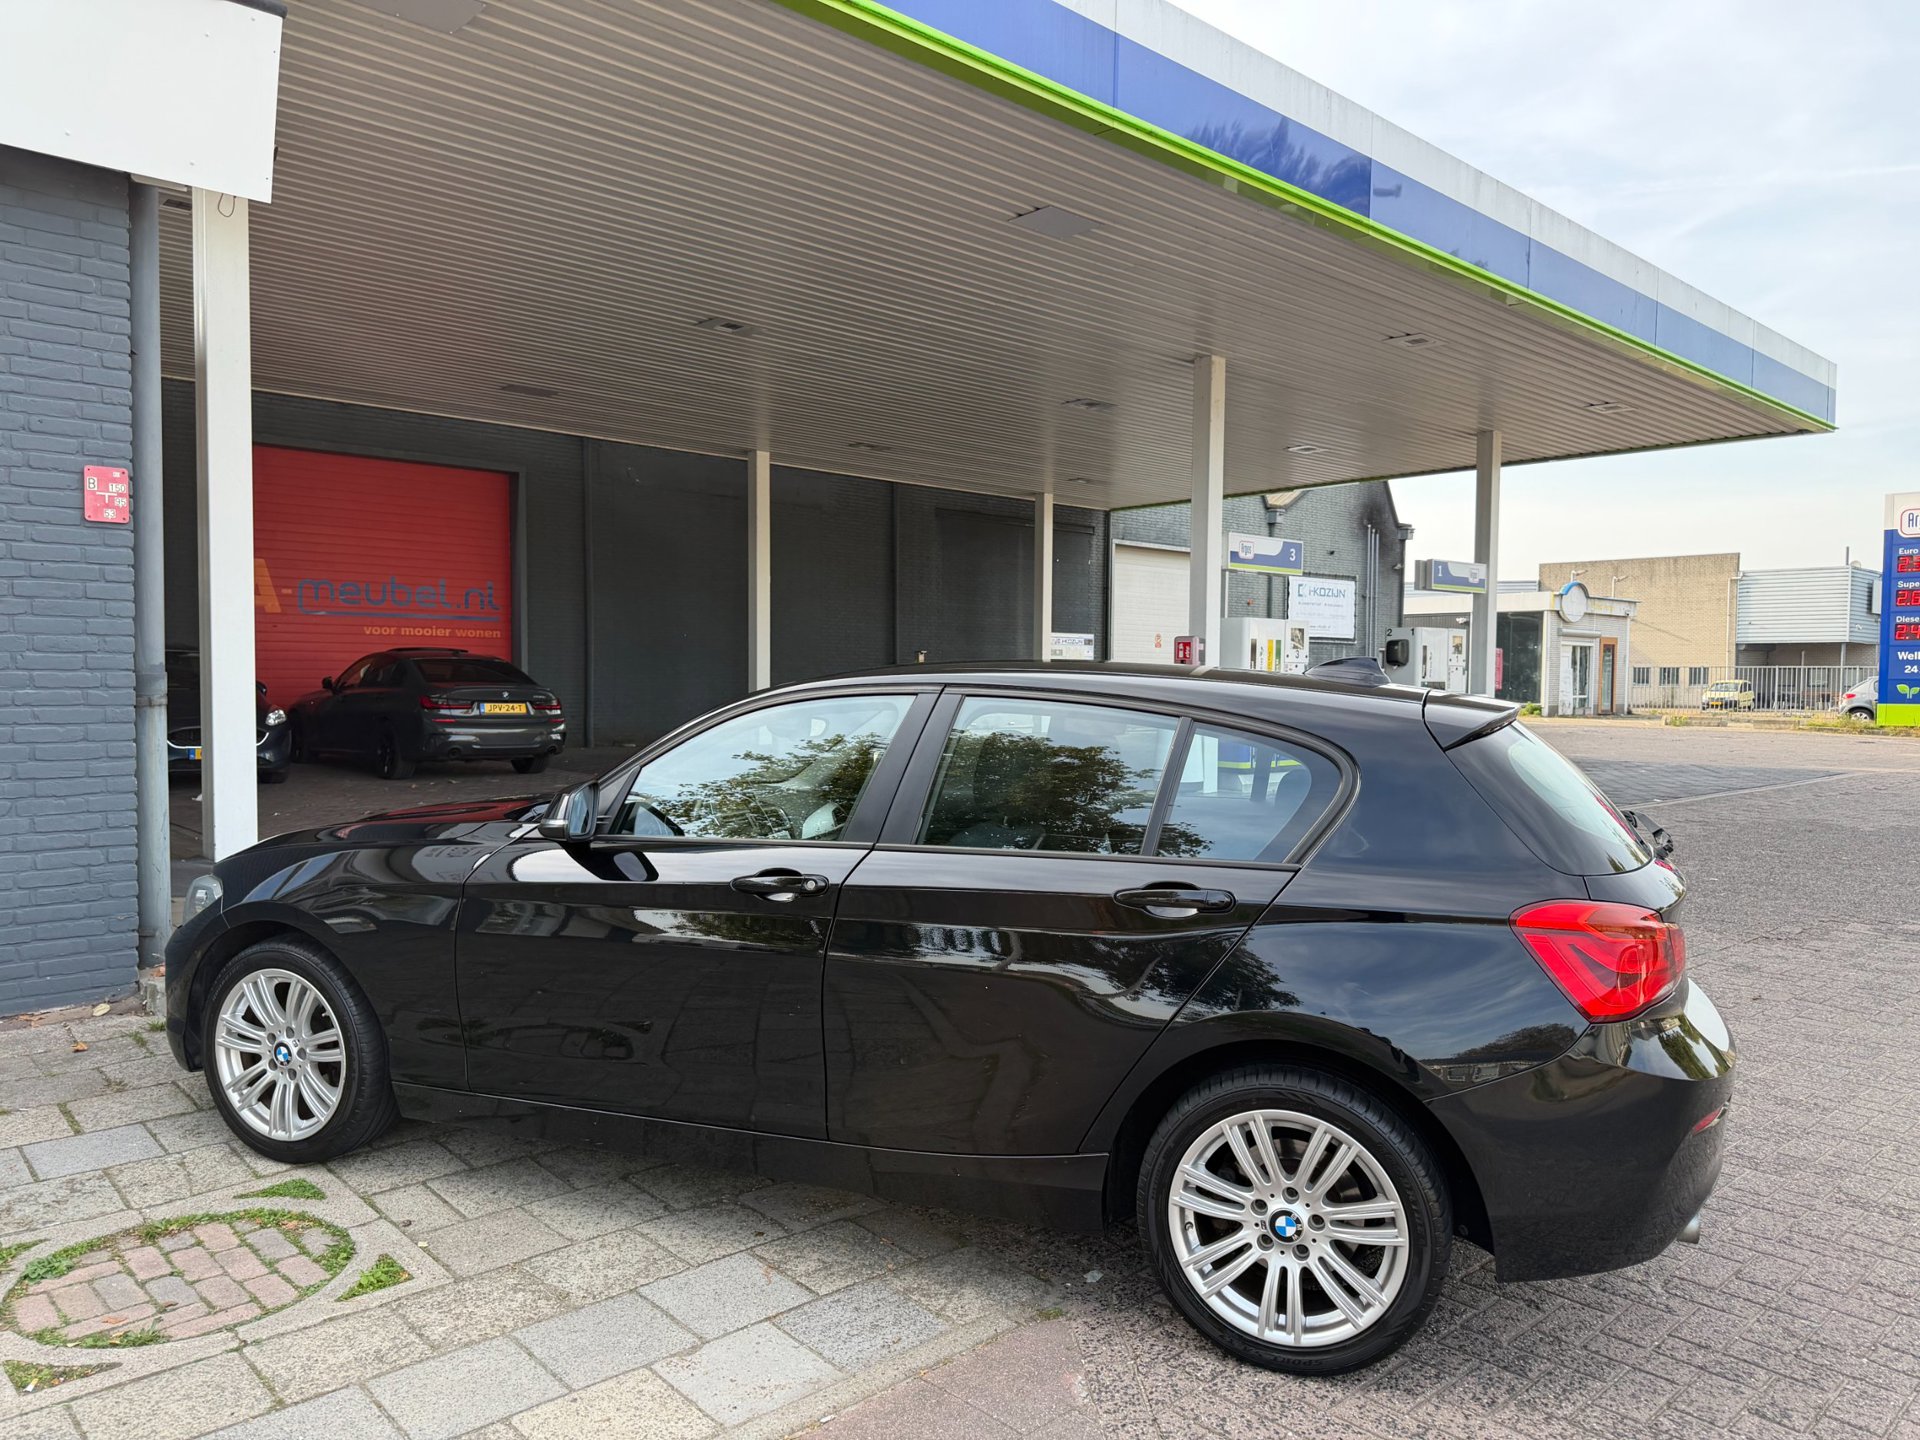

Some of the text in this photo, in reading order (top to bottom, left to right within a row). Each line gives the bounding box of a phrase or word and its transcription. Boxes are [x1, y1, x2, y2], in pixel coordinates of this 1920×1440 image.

[88, 477, 96, 489] B
[110, 484, 126, 493] 150
[1908, 512, 1920, 530] Ar
[1289, 548, 1296, 561] 3
[1898, 547, 1919, 555] Euro
[363, 625, 501, 638] voor mooier wonen
[1386, 628, 1393, 637] 2
[1895, 625, 1920, 640] 2.4
[1904, 665, 1920, 674] 24
